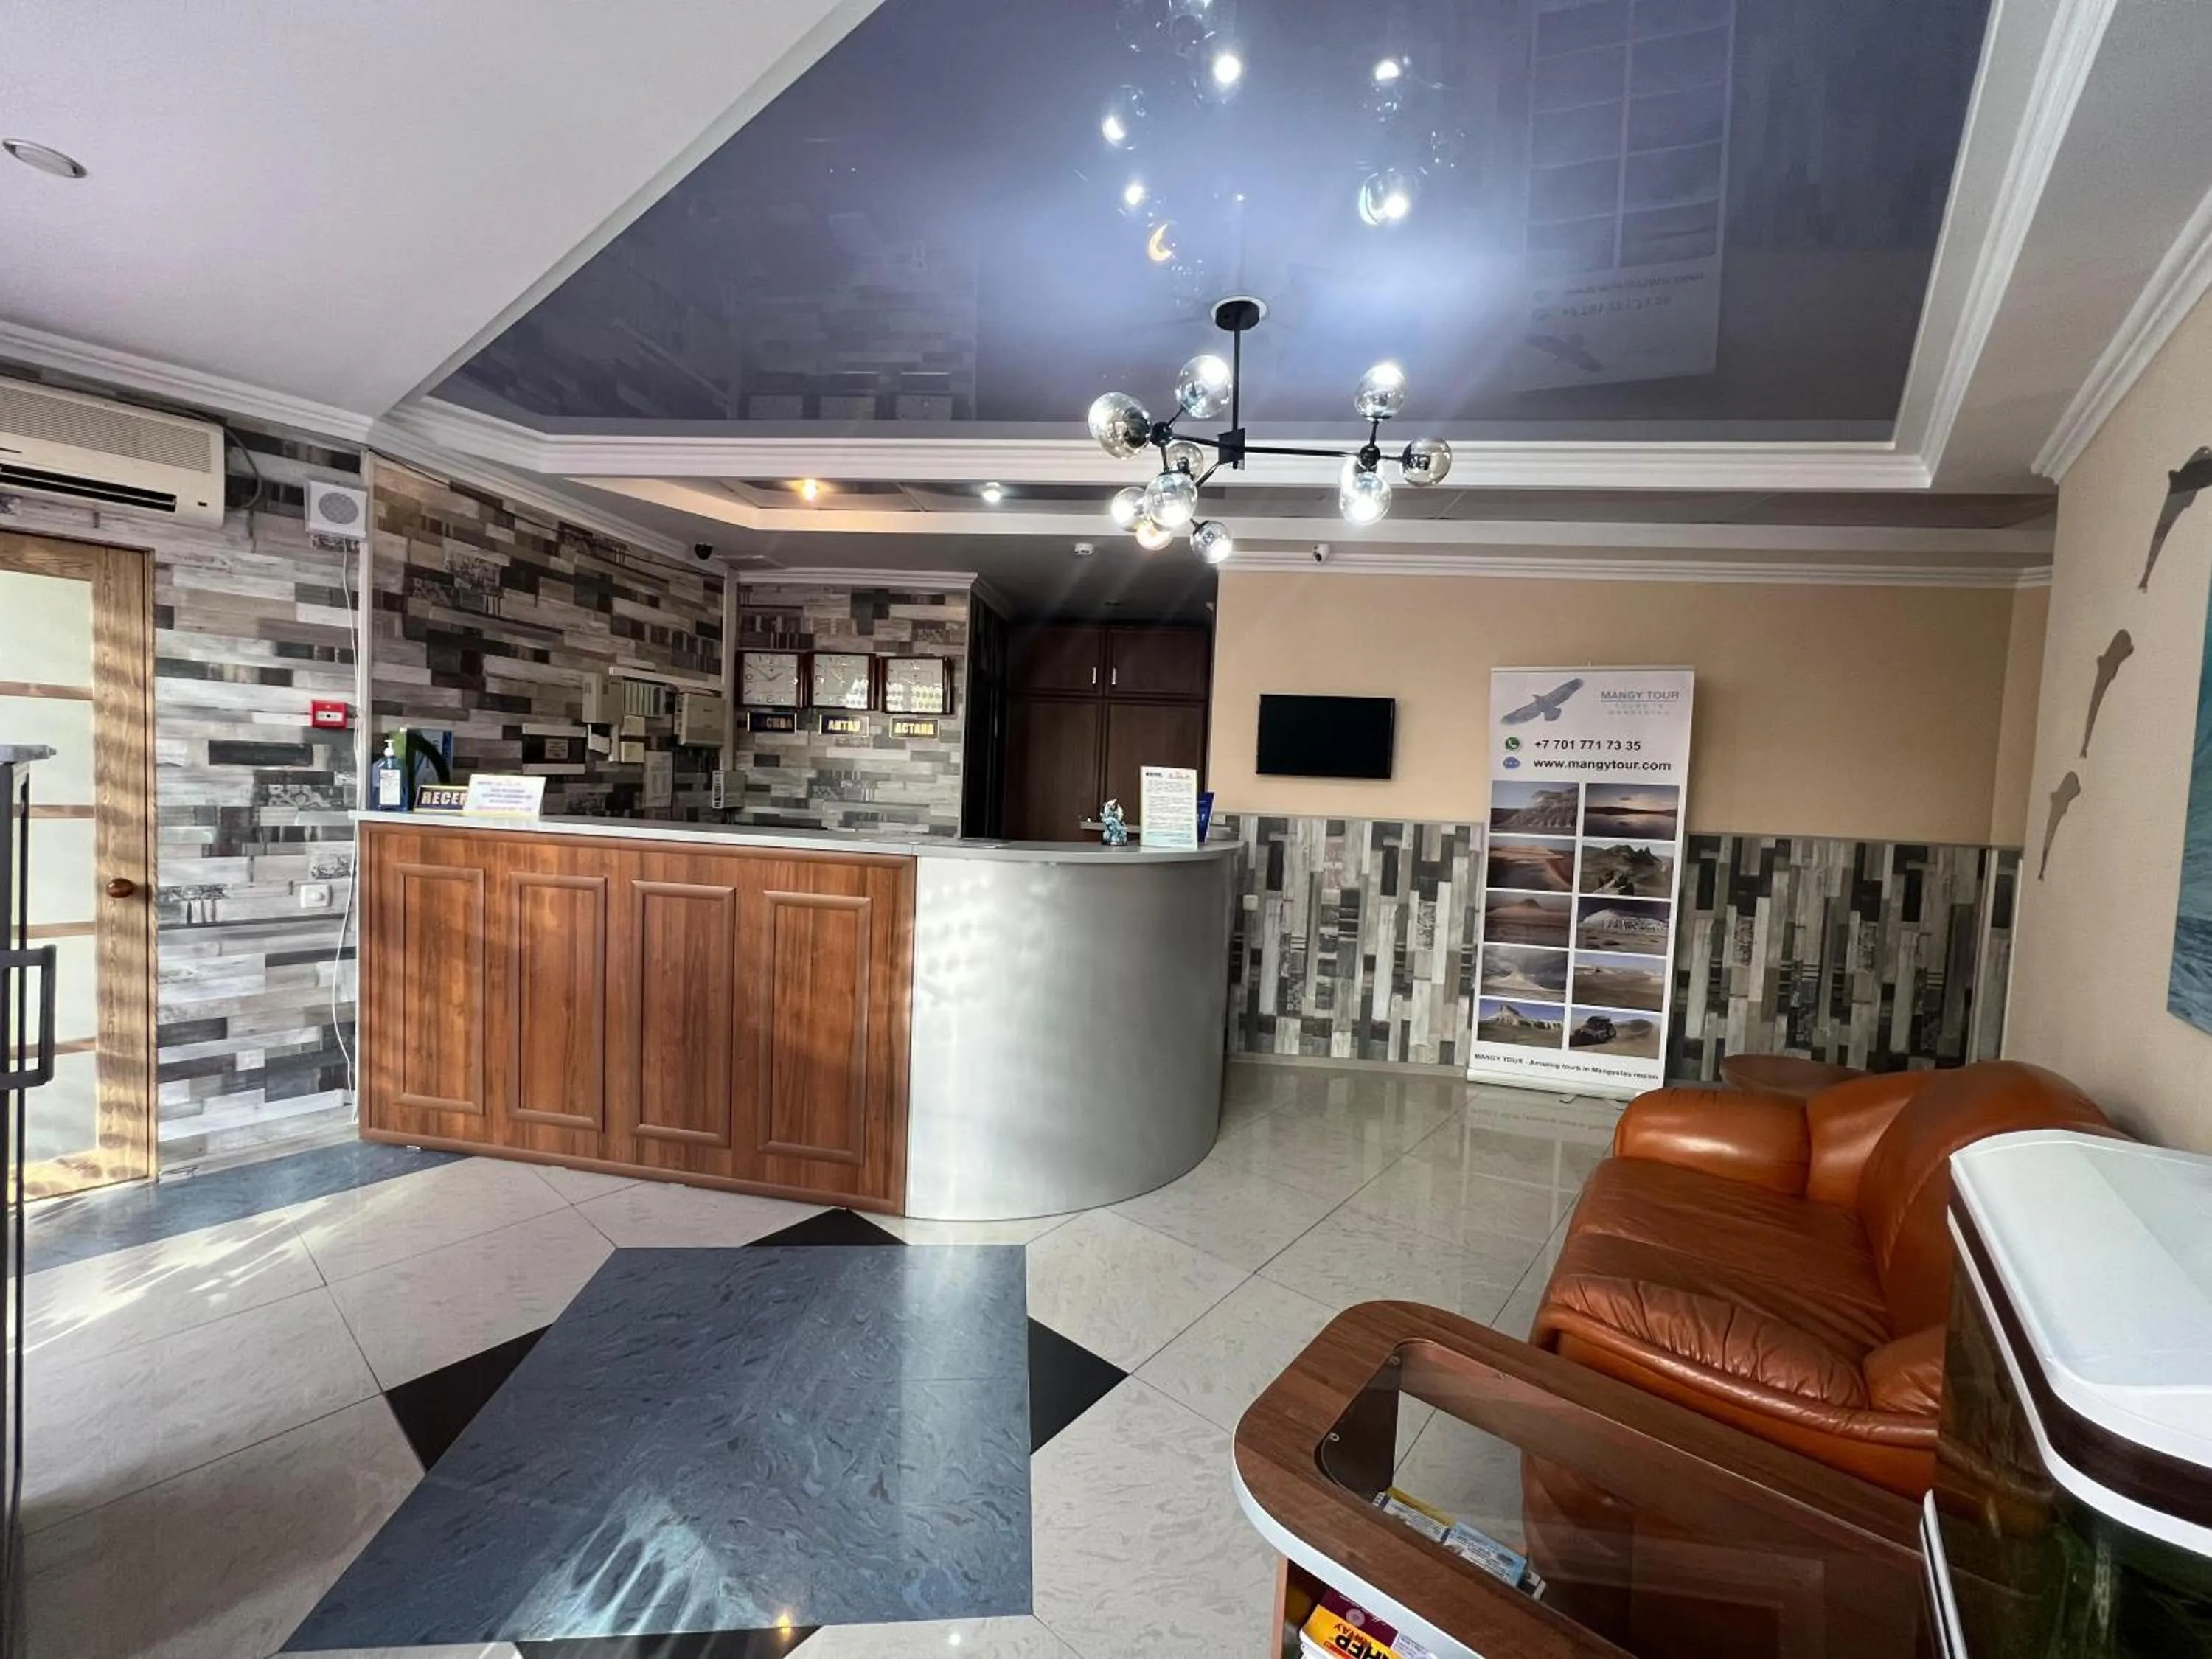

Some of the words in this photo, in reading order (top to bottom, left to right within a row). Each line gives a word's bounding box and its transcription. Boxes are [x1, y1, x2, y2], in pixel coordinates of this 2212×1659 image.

[1601, 690, 1641, 700] MANGY
[1647, 690, 1680, 700] TOUR
[1534, 740, 1550, 751] +7
[1554, 740, 1575, 751] 701
[1580, 740, 1601, 751] 771
[1607, 740, 1621, 751] 73
[1625, 740, 1641, 751] 35
[1534, 759, 1672, 771] www.mangytour.com
[1474, 1053, 1500, 1062] MANGY
[1503, 1055, 1523, 1064] TOUR
